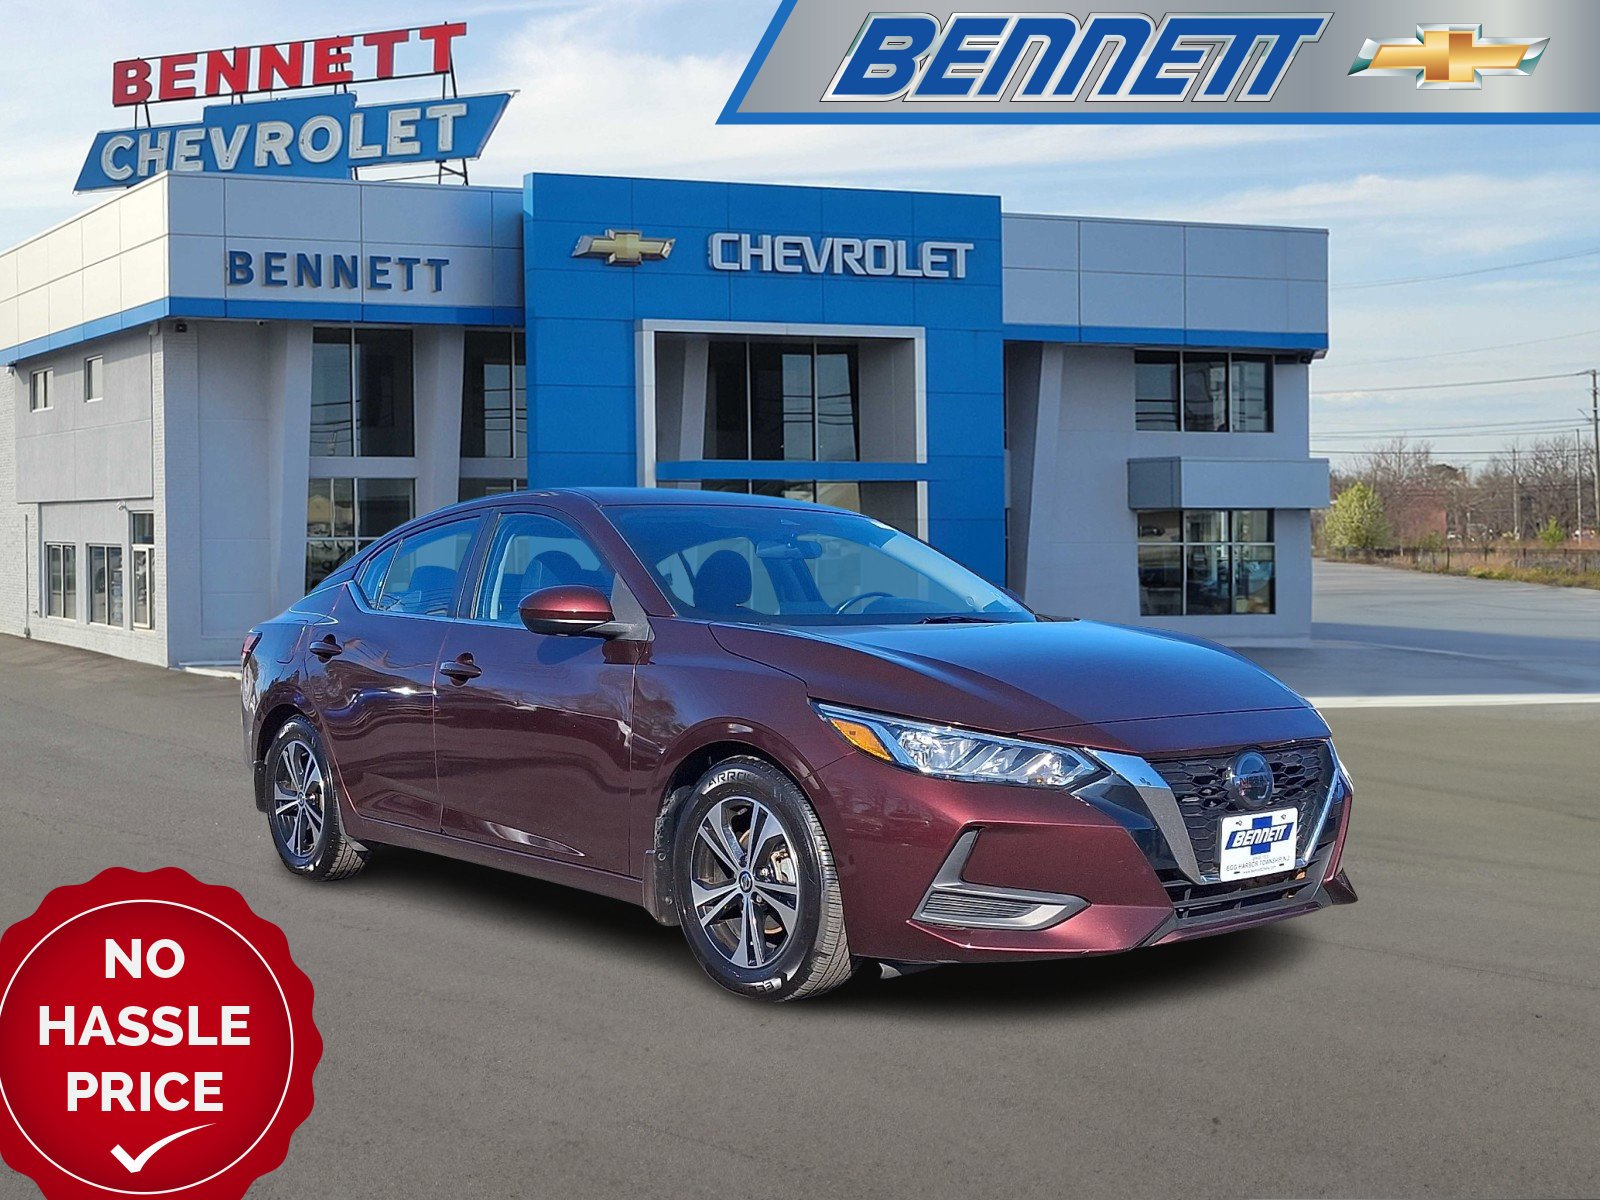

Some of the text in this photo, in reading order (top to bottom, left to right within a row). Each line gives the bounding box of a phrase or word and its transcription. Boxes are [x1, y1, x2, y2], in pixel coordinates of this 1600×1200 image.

[112, 22, 467, 107] BENNETT
[100, 103, 467, 181] CHEVROLET
[227, 250, 450, 292] BENNETT
[708, 232, 974, 278] CHEVROLET
[1231, 824, 1289, 847] BENNETT
[1226, 863, 1238, 871] EGG
[1238, 860, 1259, 869] HARBOR
